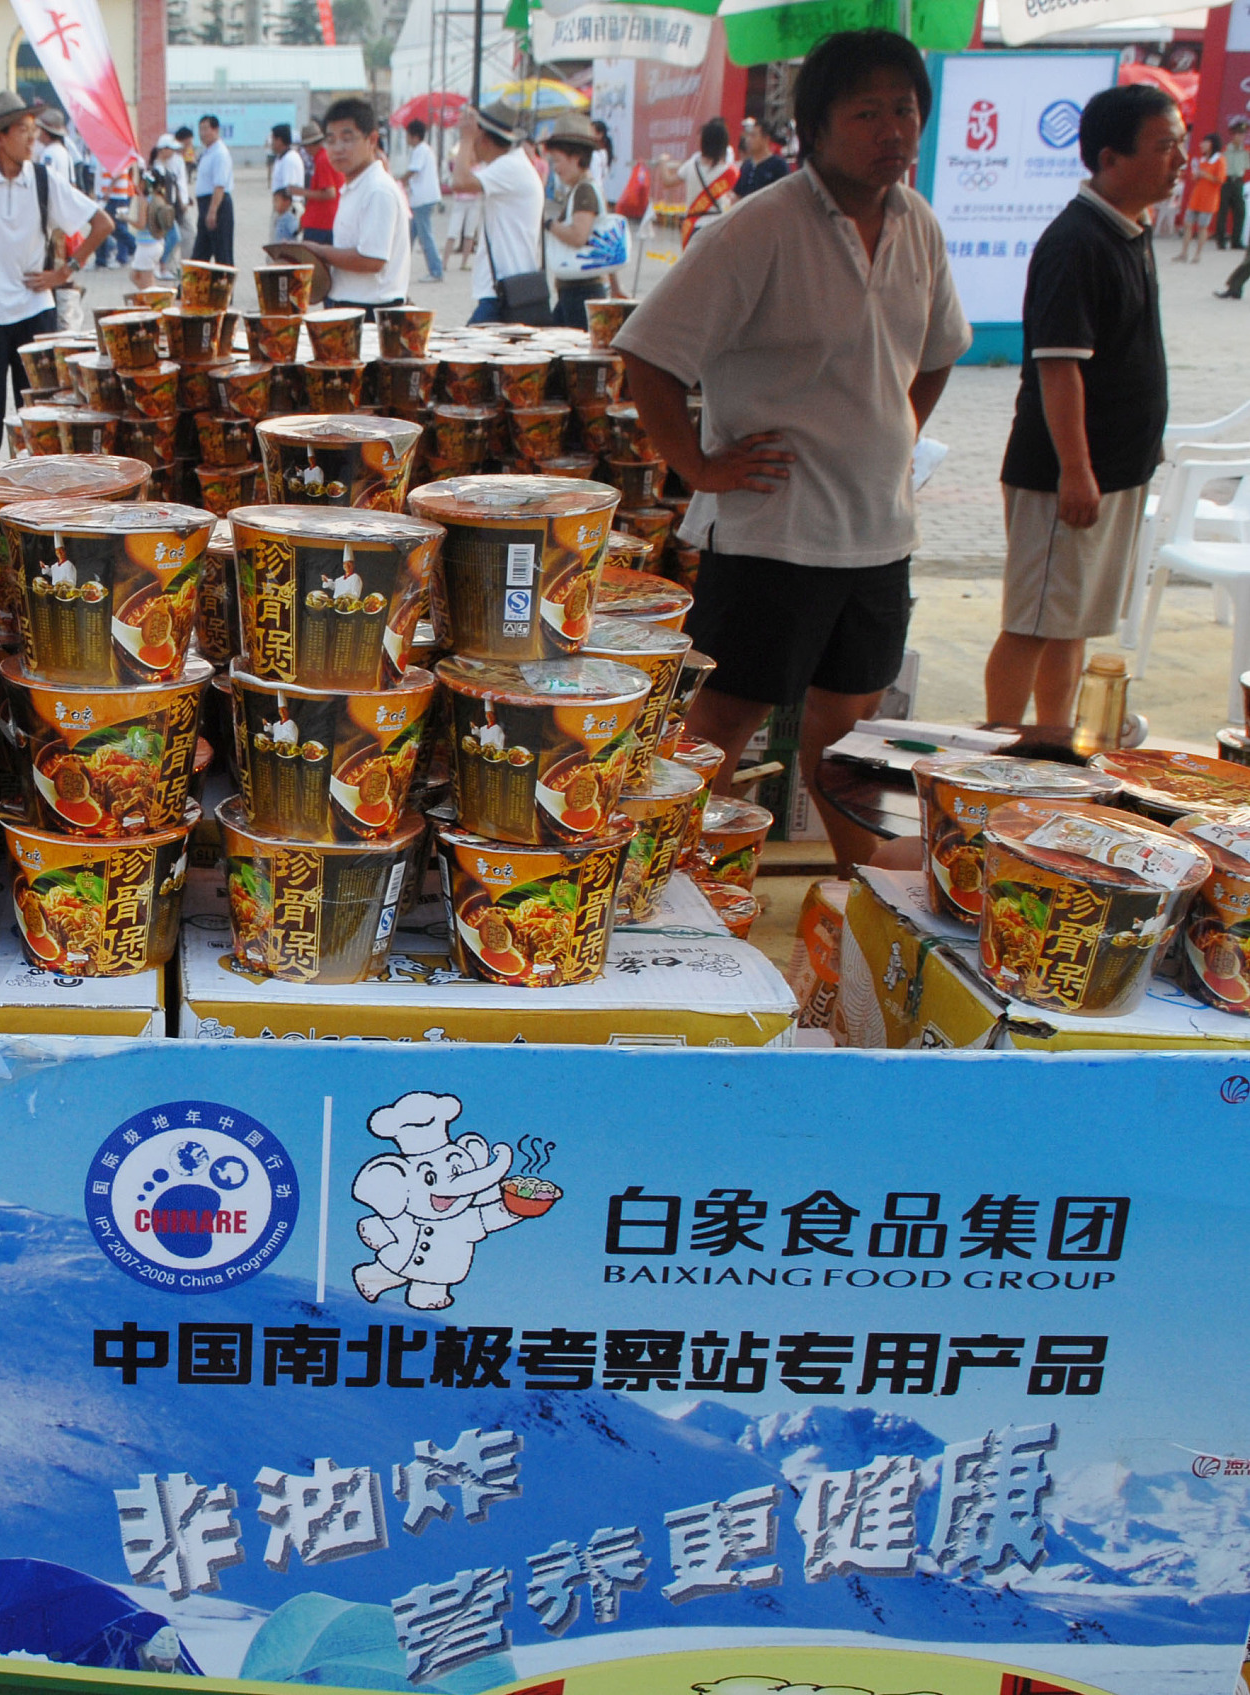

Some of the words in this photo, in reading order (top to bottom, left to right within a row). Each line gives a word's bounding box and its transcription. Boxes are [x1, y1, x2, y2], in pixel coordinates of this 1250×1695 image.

[37, 10, 82, 60] 卡
[255, 540, 297, 681] 珍骨煲
[150, 693, 200, 828] 珍骨煲
[97, 849, 153, 975] 珍骨煲
[267, 851, 321, 981] 珍骨煲
[563, 851, 617, 979] 珍骨煲
[1025, 883, 1106, 1012] 珍骨煲
[92, 1109, 293, 1199] 国际极地年中国行动
[95, 1215, 116, 1242] IPY
[107, 1239, 176, 1286] 2007-2008
[180, 1273, 224, 1288] China
[227, 1220, 288, 1280] Programme
[134, 1209, 248, 1234] CHINARE
[603, 1186, 1132, 1262] 白象食品集团
[603, 1264, 812, 1288] BAIXIANG
[824, 1267, 951, 1290] FOOD
[963, 1269, 1117, 1291] GROUP
[92, 1321, 1110, 1397] 中国南北极考察站专用产品
[114, 1427, 524, 1602] 非油炸
[391, 1421, 1060, 1685] 营养更健康
